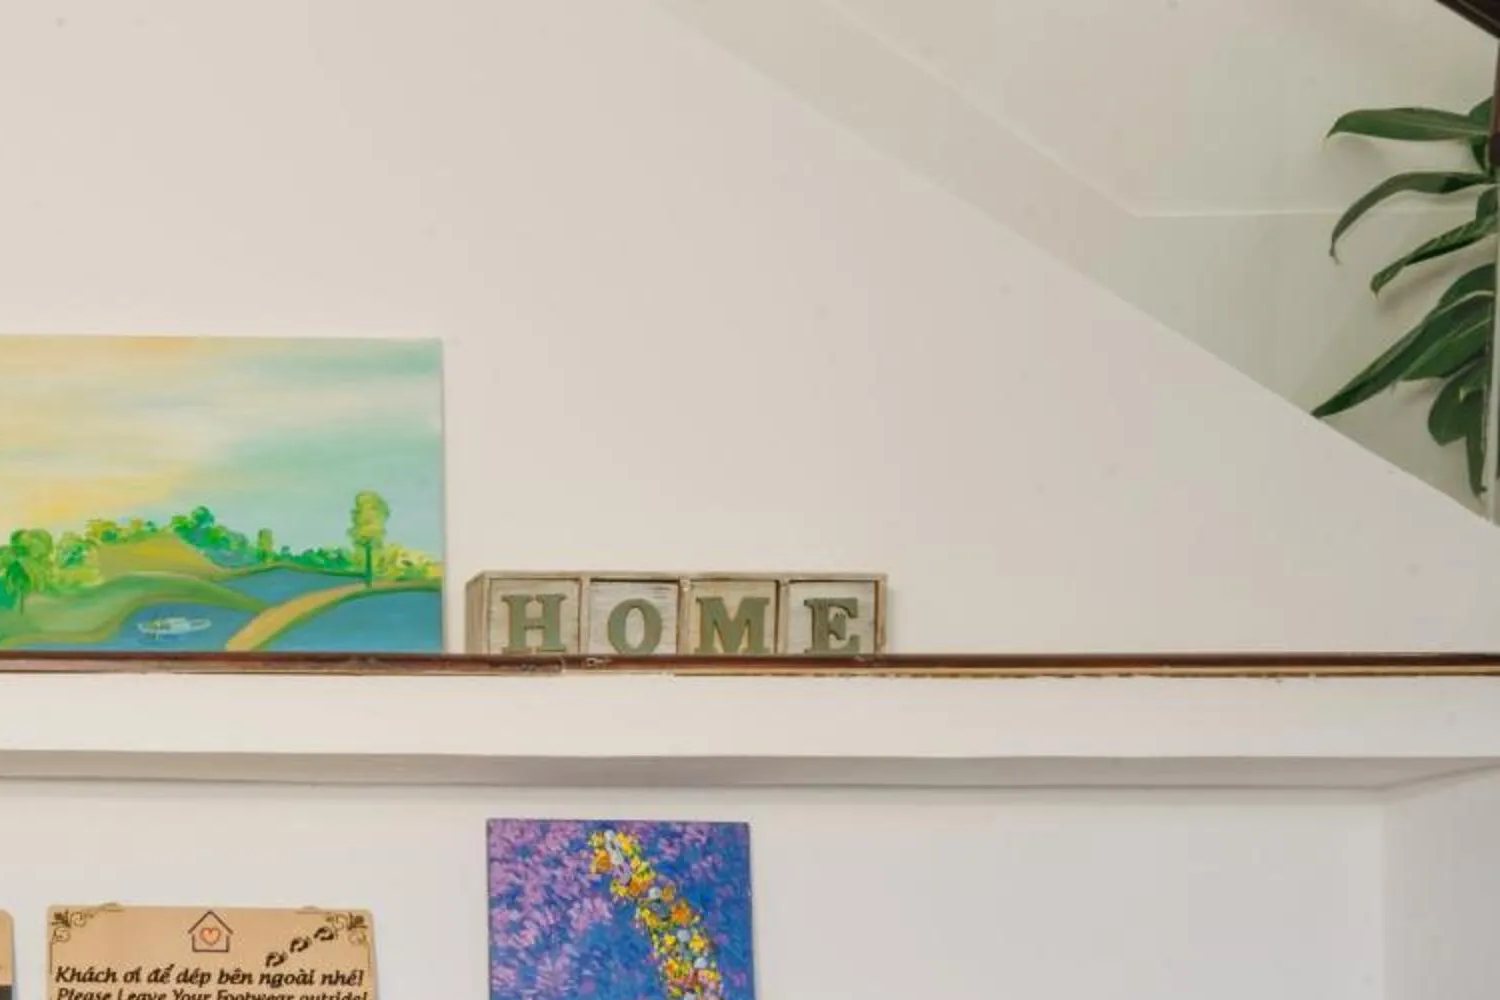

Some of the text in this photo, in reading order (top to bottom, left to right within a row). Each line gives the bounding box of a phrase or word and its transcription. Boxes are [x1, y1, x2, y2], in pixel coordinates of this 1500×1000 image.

[501, 594, 859, 656] HOME
[55, 965, 118, 983] Khách
[146, 963, 175, 984] để
[176, 967, 213, 988] dép
[217, 967, 254, 985] bên
[258, 968, 316, 989] ngoài
[320, 968, 365, 986] nhé!
